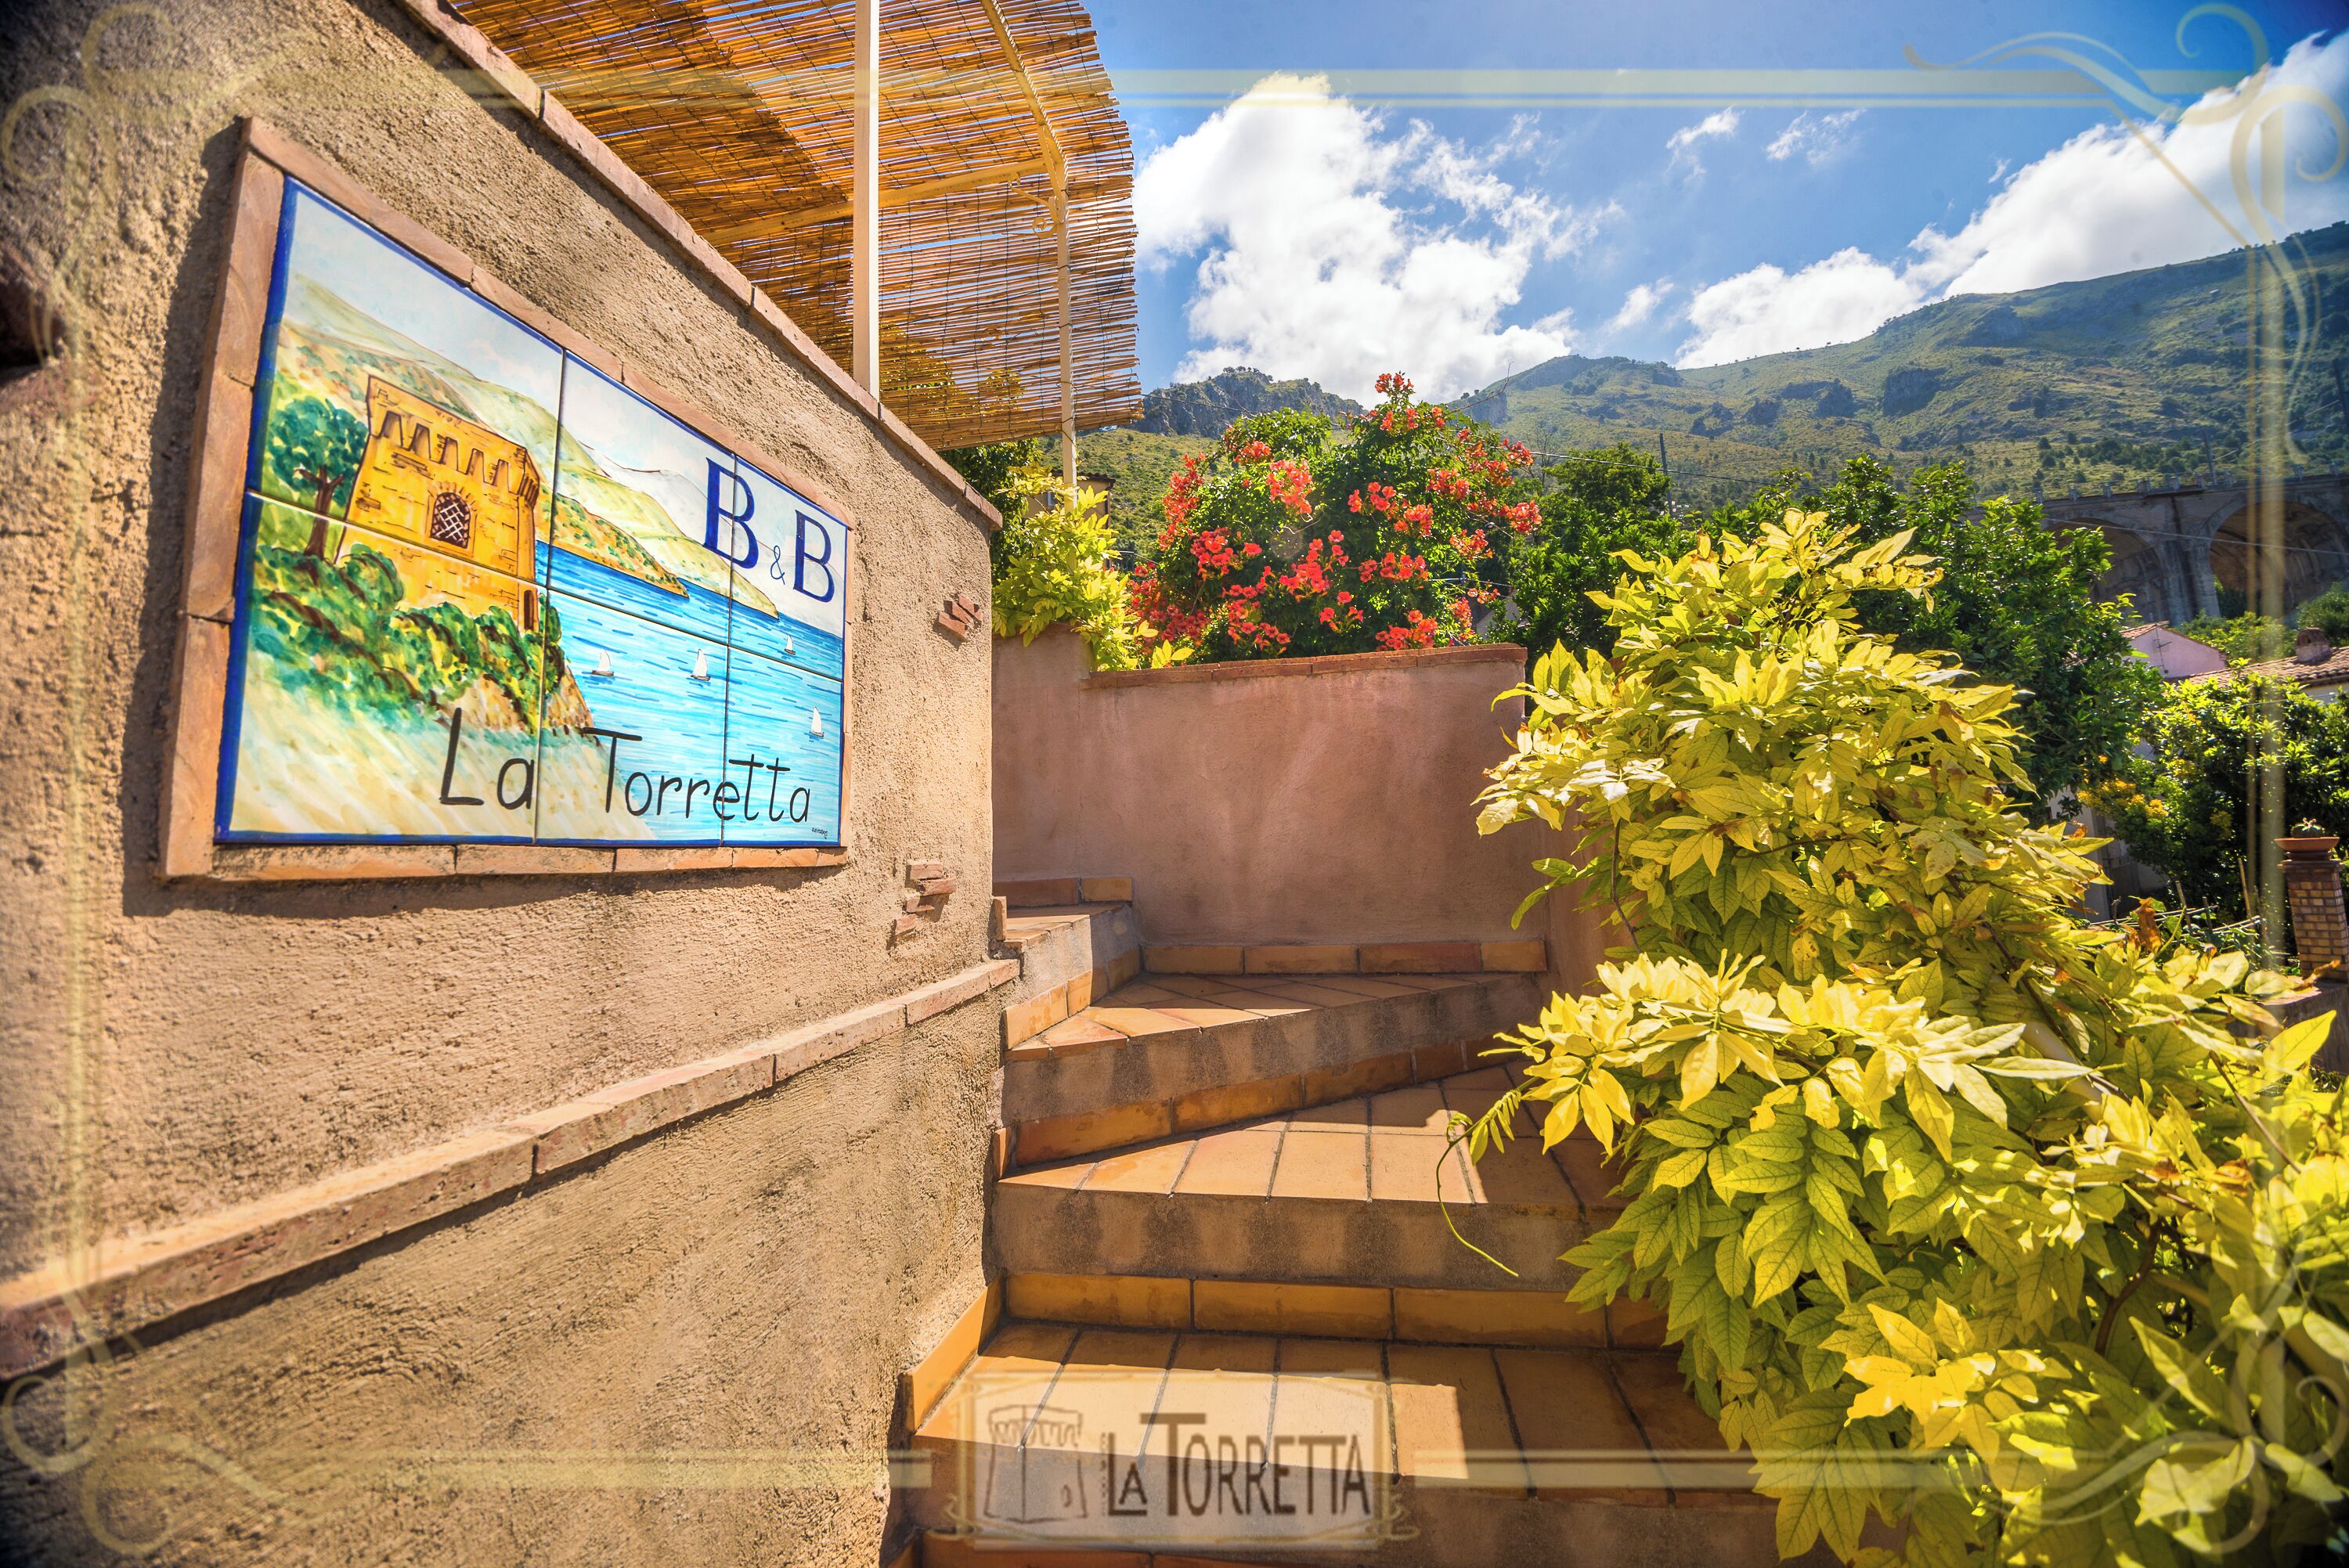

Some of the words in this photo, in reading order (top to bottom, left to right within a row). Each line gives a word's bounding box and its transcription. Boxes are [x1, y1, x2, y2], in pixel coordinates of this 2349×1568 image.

[703, 457, 759, 569] B
[770, 545, 785, 586] &
[793, 510, 835, 603] B
[439, 708, 535, 810] La
[582, 726, 810, 823] Torretta
